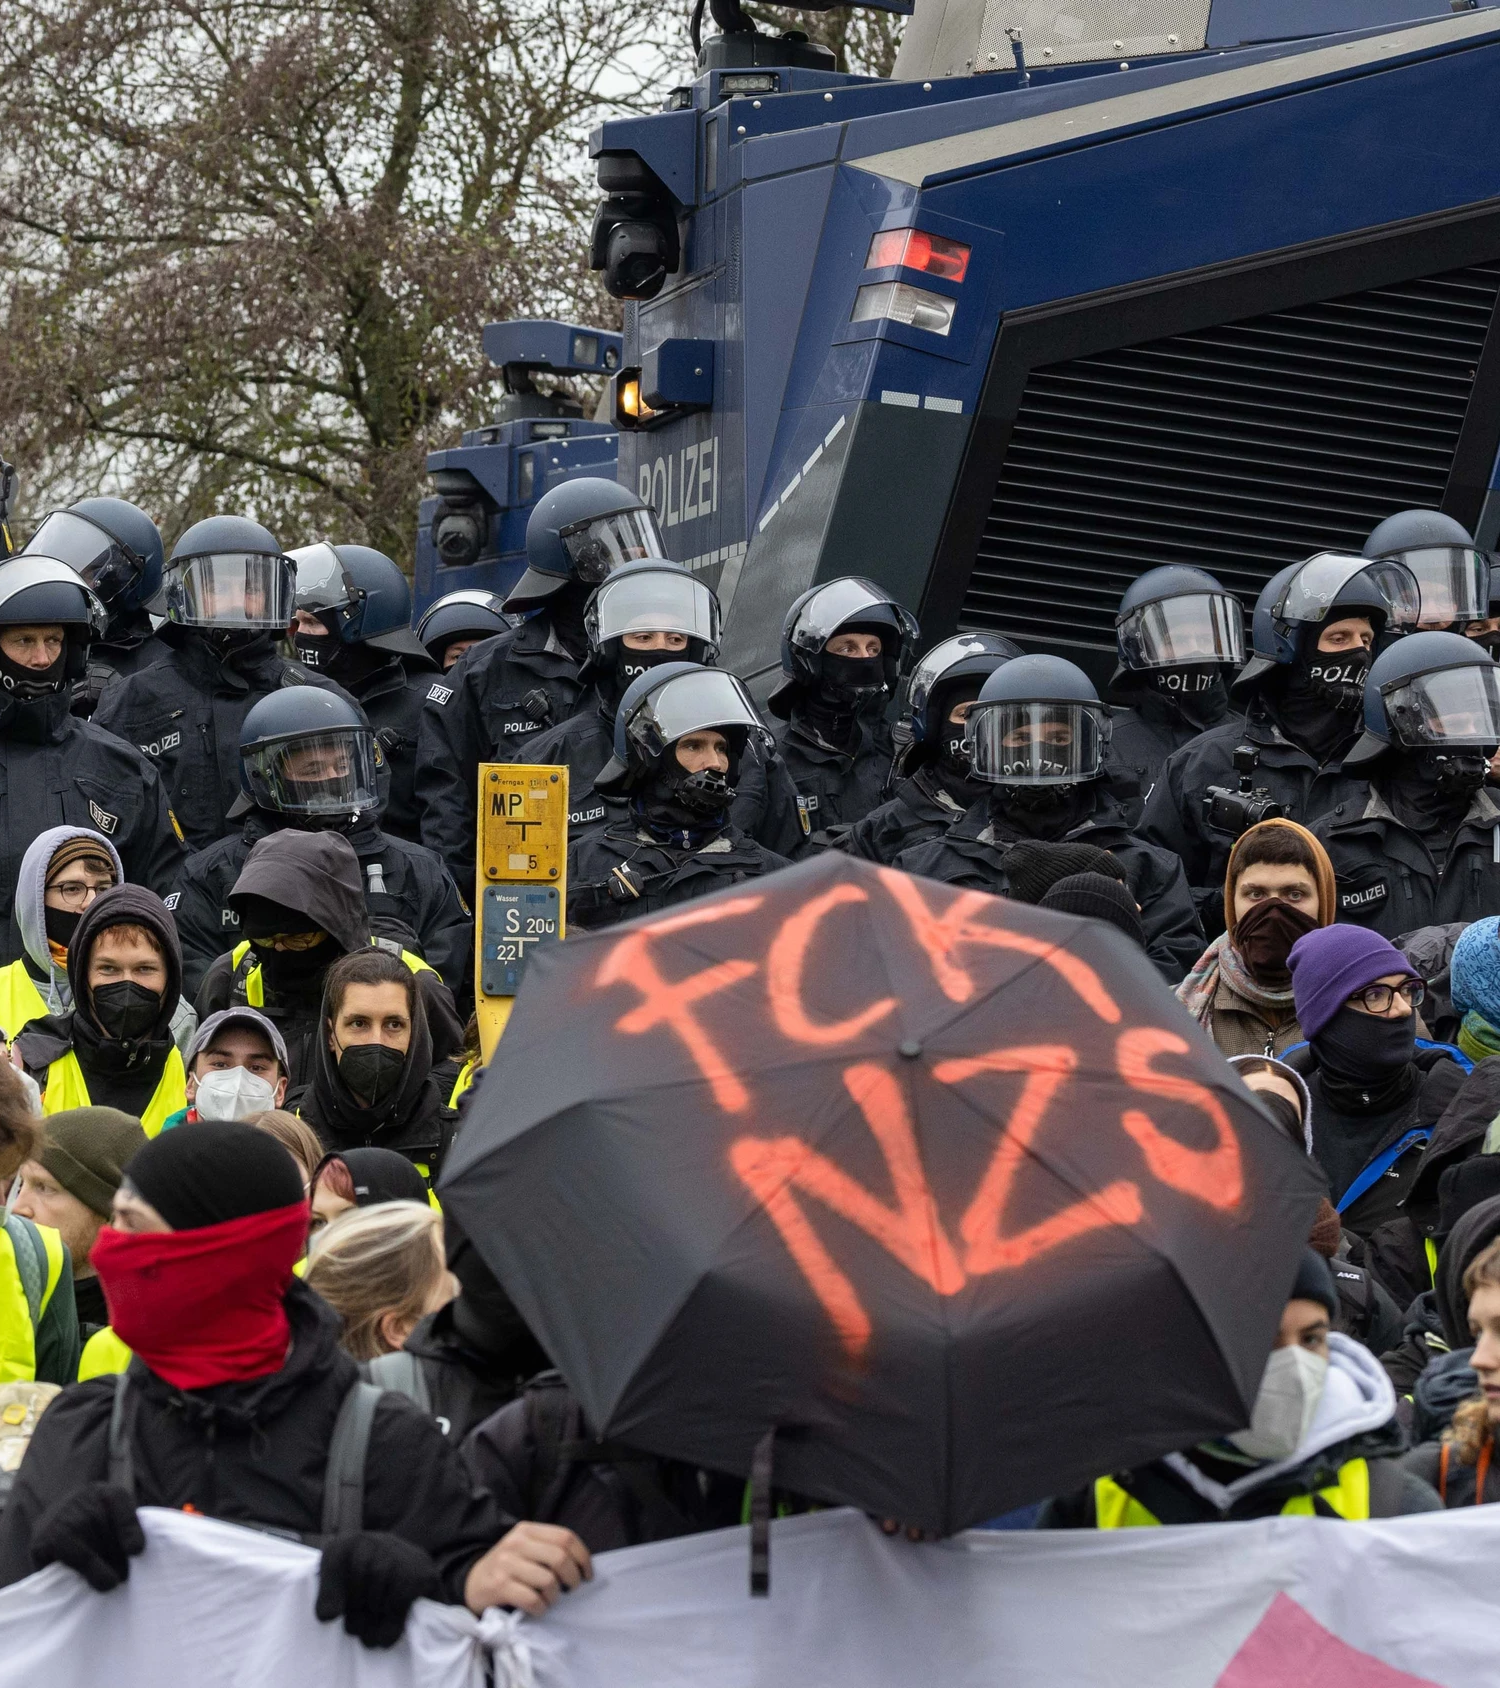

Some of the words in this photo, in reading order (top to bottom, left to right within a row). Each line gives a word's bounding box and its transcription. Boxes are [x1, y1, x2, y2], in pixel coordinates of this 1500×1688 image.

[639, 436, 718, 528] POLIZEI
[140, 731, 180, 756] POLIZEI
[497, 778, 524, 787] Ferngas
[492, 793, 523, 817] MP
[495, 894, 519, 902] Wasser
[1342, 884, 1386, 906] POLIZEI
[506, 908, 520, 933] S
[526, 918, 555, 934] 200
[593, 867, 1122, 1115] FCK
[728, 1026, 1245, 1362] NZS
